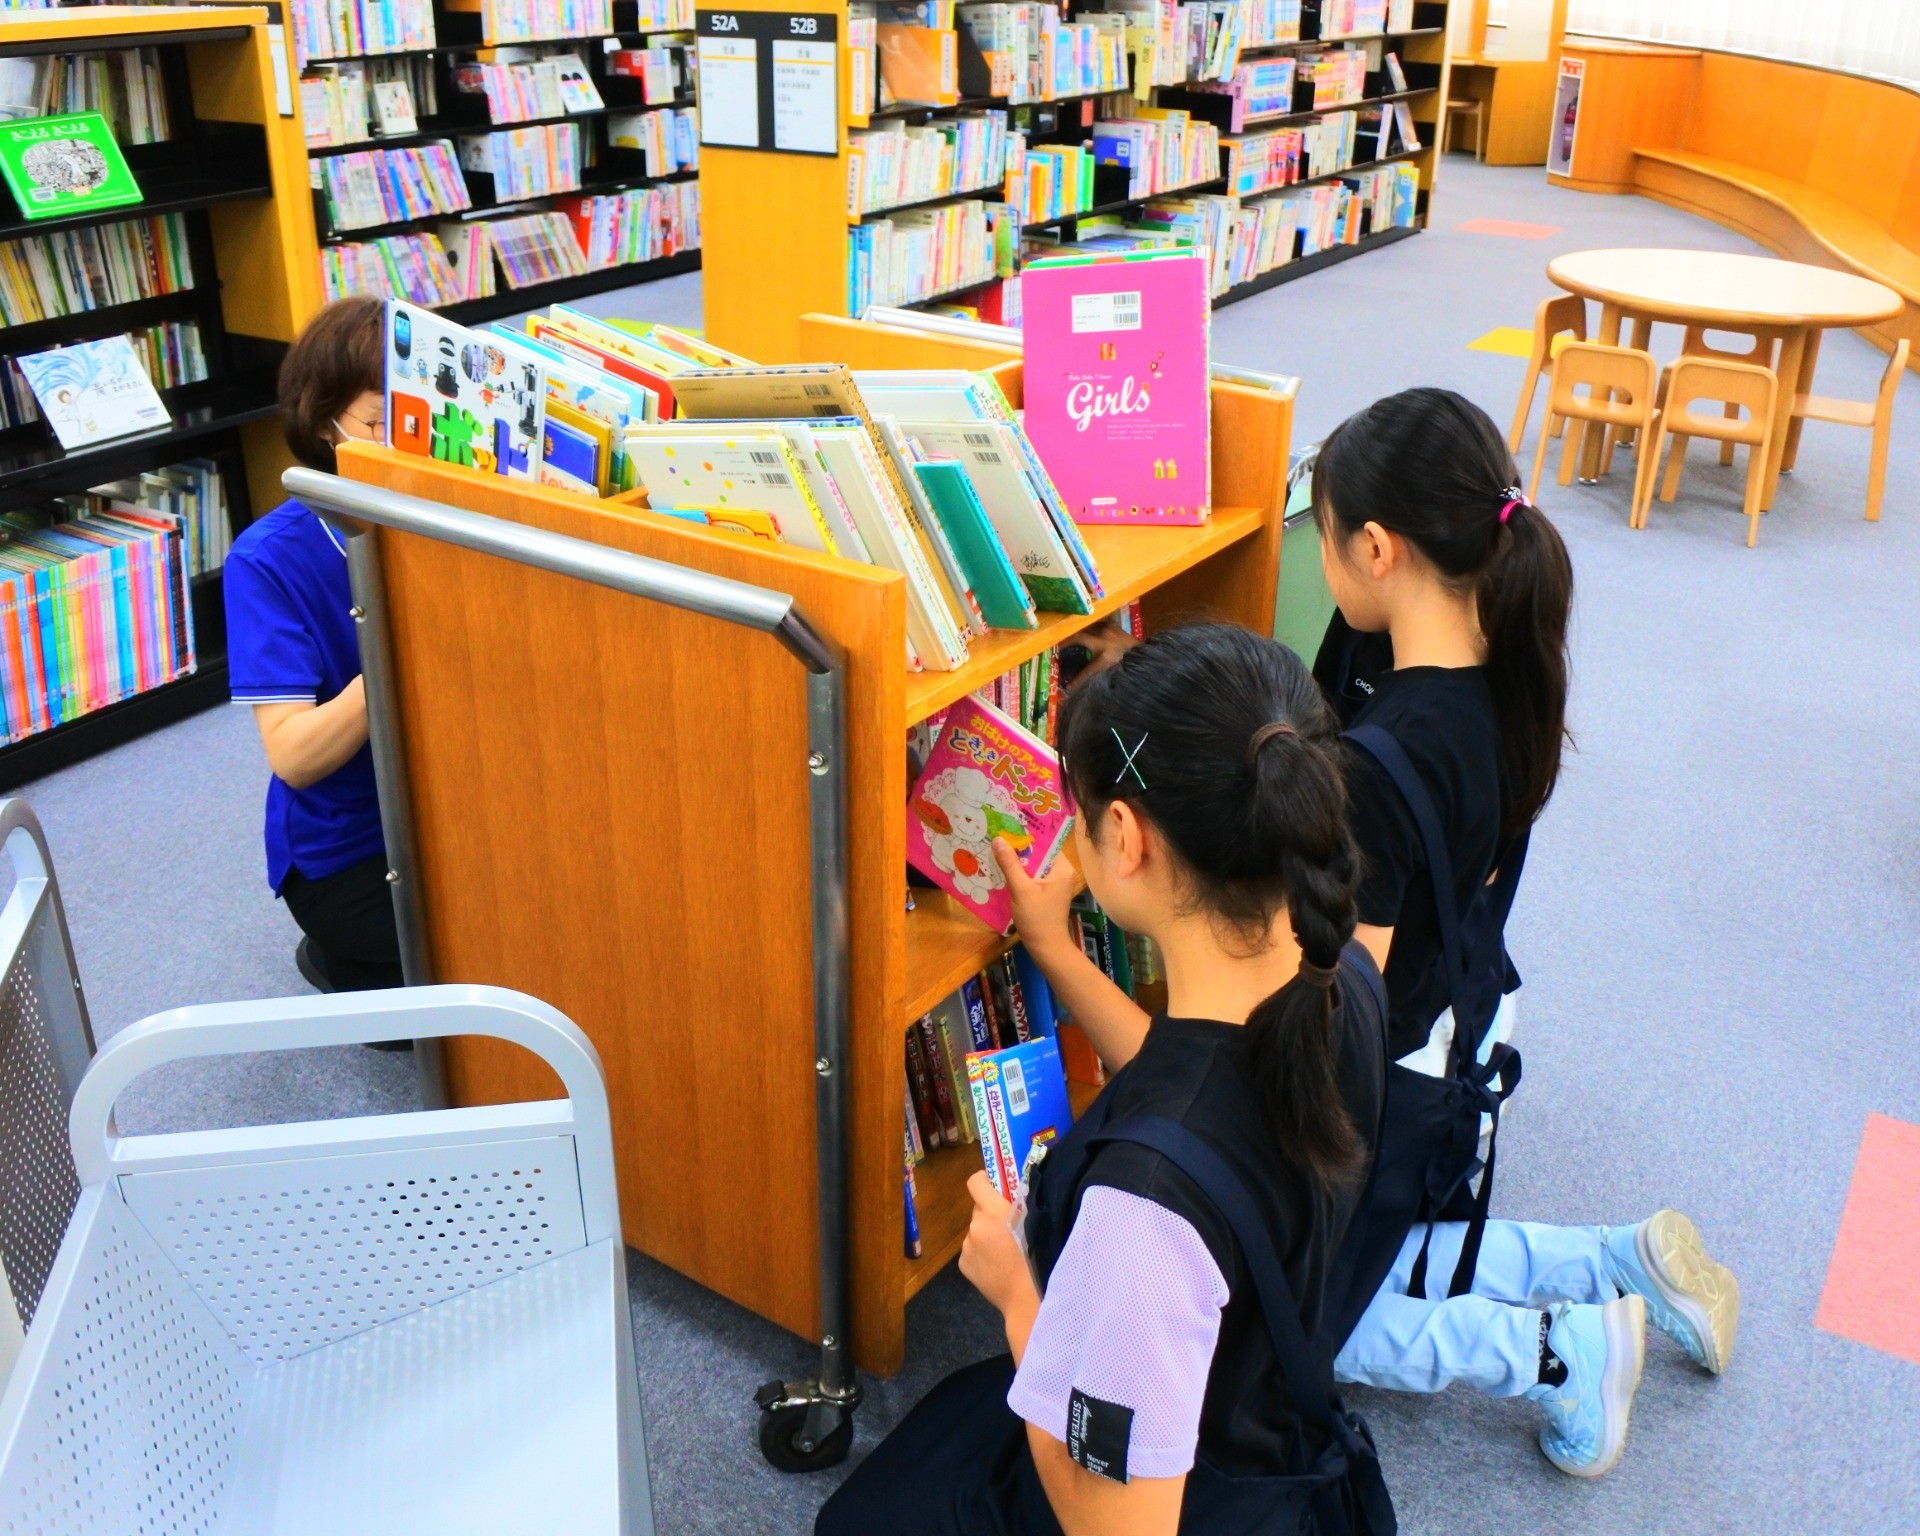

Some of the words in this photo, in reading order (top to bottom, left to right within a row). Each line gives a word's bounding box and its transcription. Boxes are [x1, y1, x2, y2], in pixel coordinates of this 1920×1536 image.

[711, 14, 739, 31] 52A
[789, 17, 818, 35] 52B
[1066, 376, 1150, 432] Girls
[390, 390, 529, 476] ロボット
[1071, 1400, 1082, 1437] SISTER
[1086, 1453, 1110, 1468] Never
[1087, 1461, 1103, 1473] stop
